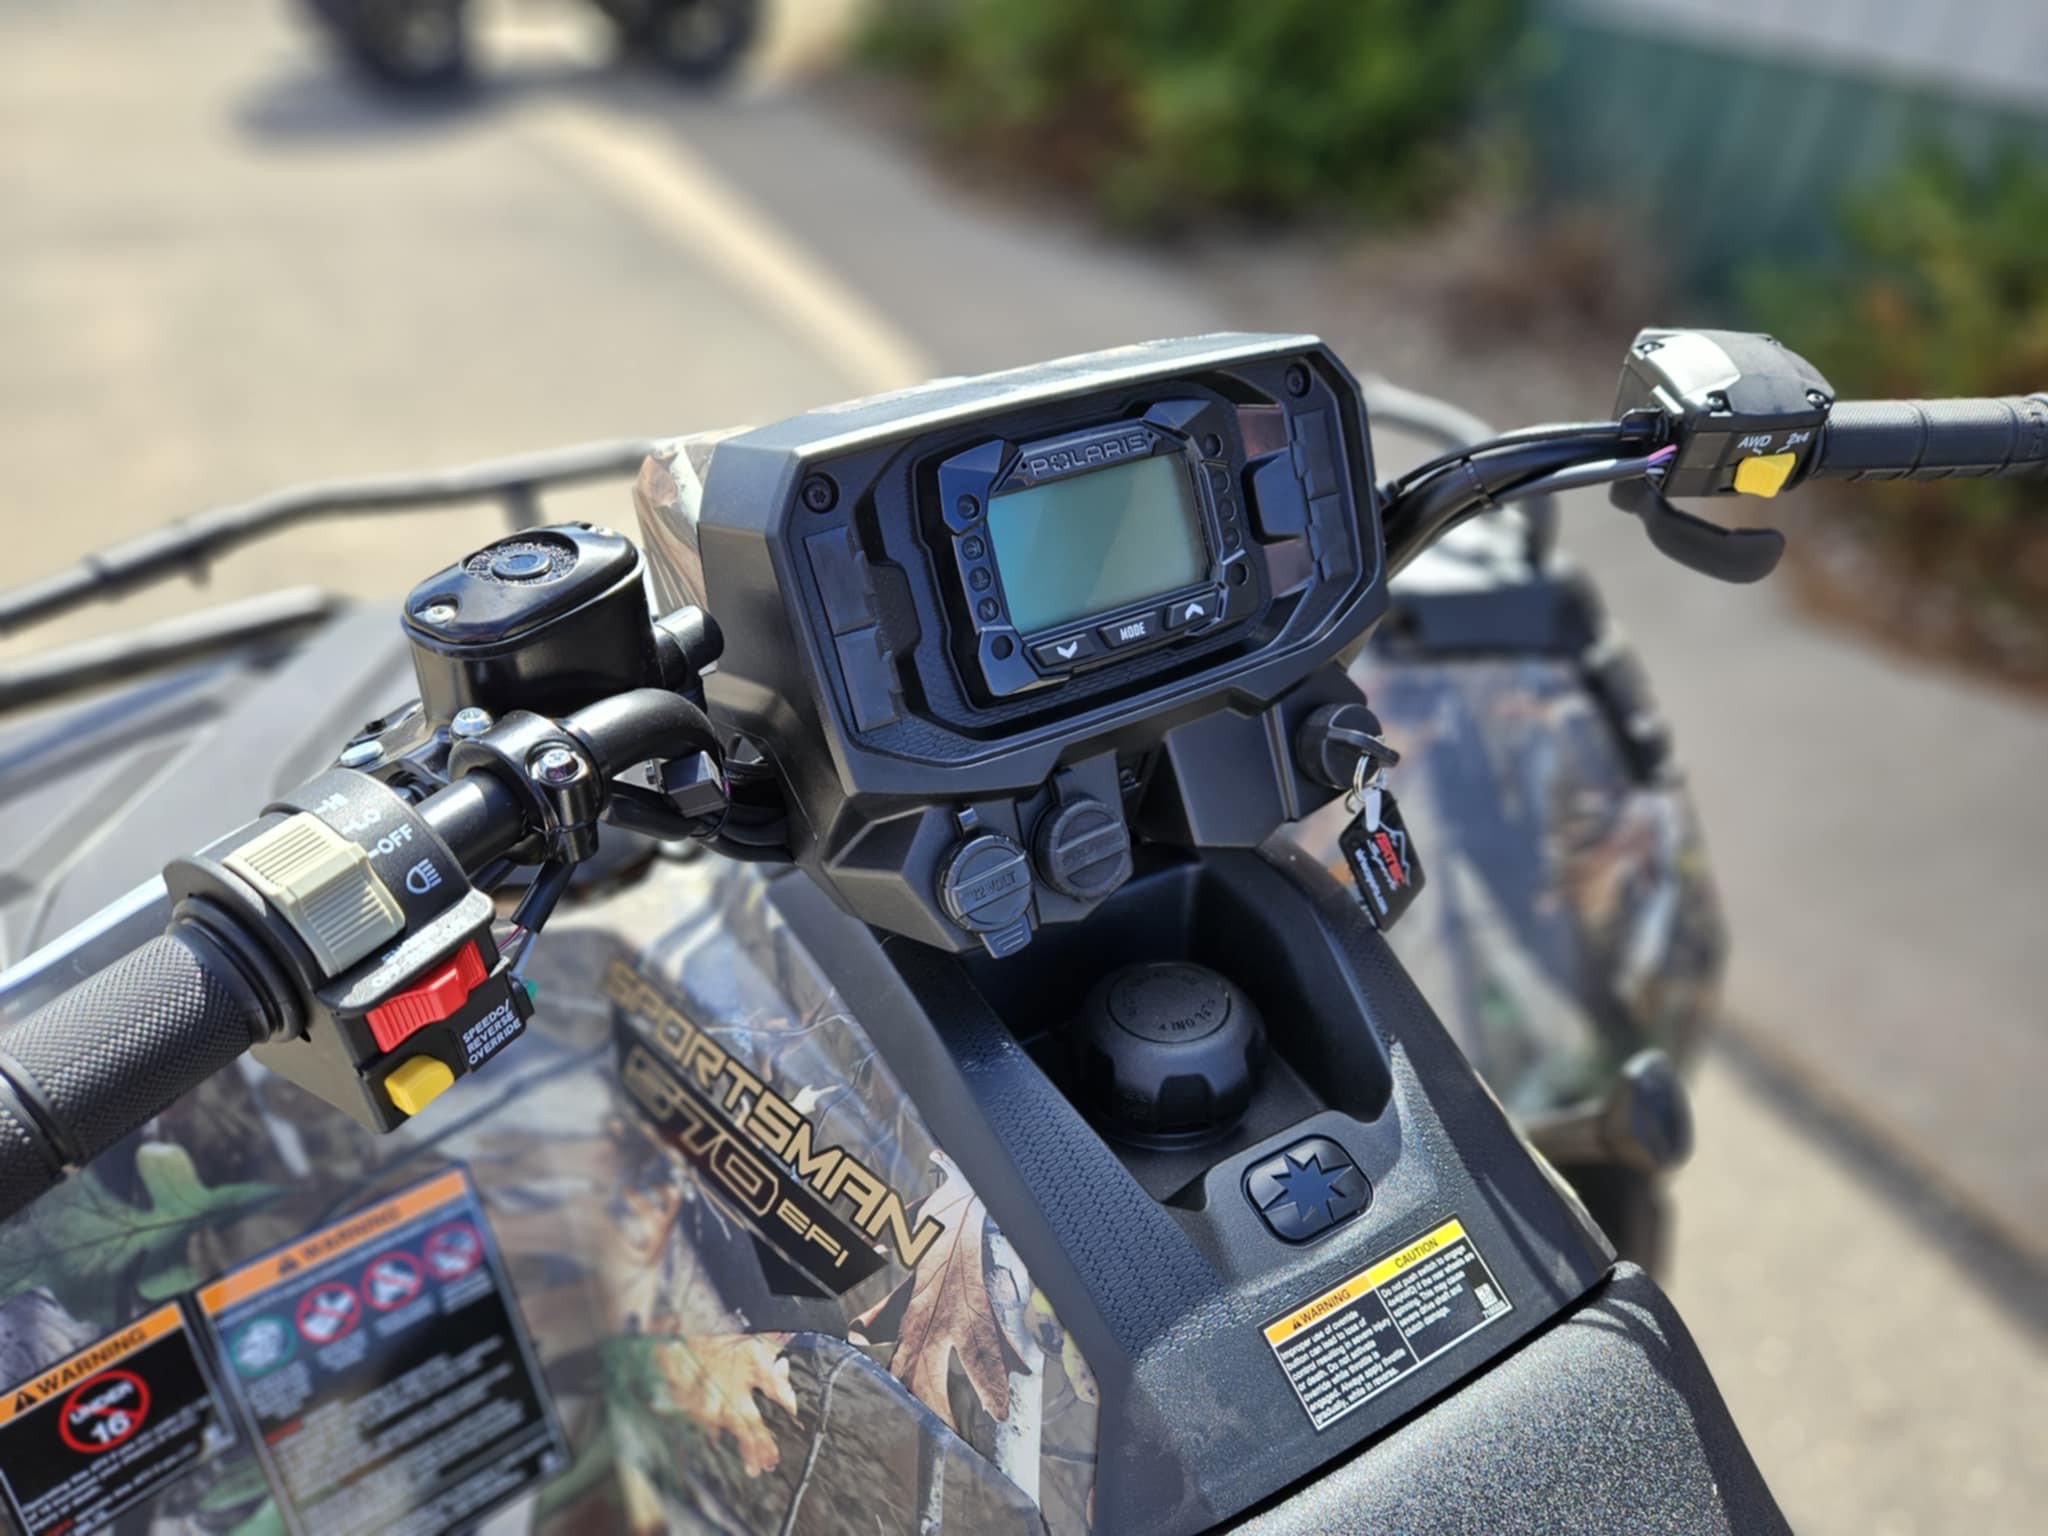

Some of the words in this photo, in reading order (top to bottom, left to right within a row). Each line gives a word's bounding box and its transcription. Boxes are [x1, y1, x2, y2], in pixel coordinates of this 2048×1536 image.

[1030, 434, 1149, 476] POLARIS
[1737, 435, 1772, 448] AWD
[1120, 622, 1146, 641] MODE
[377, 824, 412, 854] OFF
[466, 1010, 515, 1053] REVERSE
[468, 1017, 522, 1065] OVERRIDE
[605, 956, 944, 1268] SPORTSMAN
[776, 1198, 849, 1267] EFI
[1394, 1238, 1439, 1269] CAUTION
[1300, 1289, 1351, 1324] WARNING
[36, 1326, 146, 1395] WARNING
[91, 1410, 131, 1444] 16
